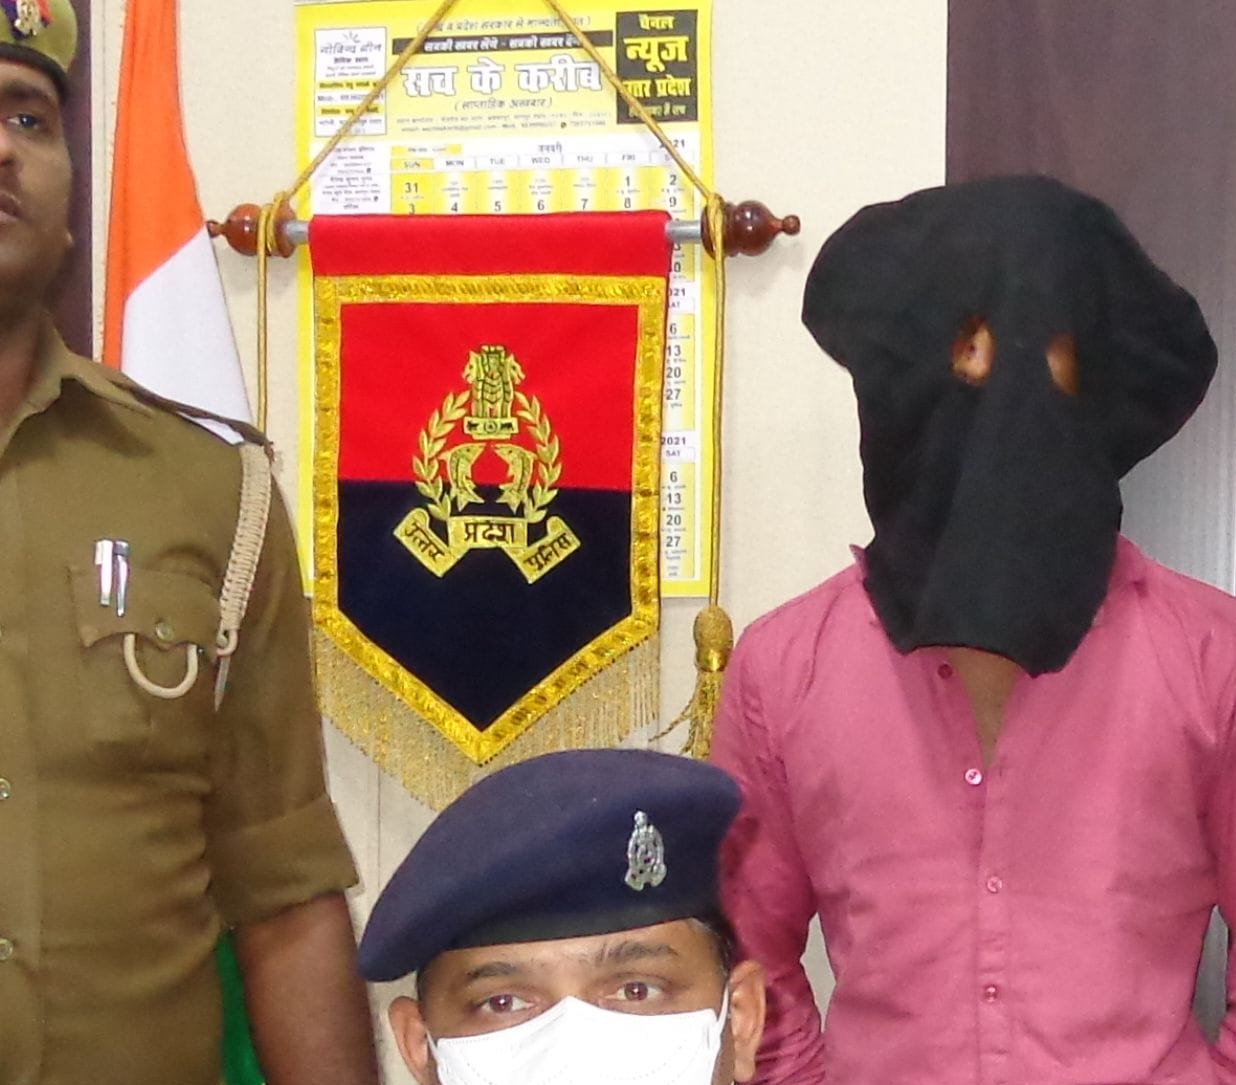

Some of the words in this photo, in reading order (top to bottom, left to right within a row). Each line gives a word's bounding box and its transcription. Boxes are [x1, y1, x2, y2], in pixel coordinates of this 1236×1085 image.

[623, 35, 689, 72] न्यूज
[401, 65, 458, 97] सच
[467, 56, 504, 94] के
[405, 182, 419, 193] 31
[669, 174, 677, 186] 2
[451, 202, 458, 212] 4
[494, 201, 502, 211] 5
[537, 199, 545, 210] 6
[581, 198, 588, 210] 7
[624, 197, 631, 209] 8
[669, 196, 677, 207] 9
[669, 323, 677, 335] 6
[667, 345, 681, 357] 13
[666, 366, 681, 379] 20
[665, 388, 681, 401] 27
[669, 471, 678, 482] 6
[667, 493, 681, 504] 13
[666, 514, 681, 526] 20
[403, 521, 446, 562] उत्तर
[463, 520, 517, 545] प्रदेश
[523, 531, 572, 572] पुलिस
[666, 536, 681, 547] 27
